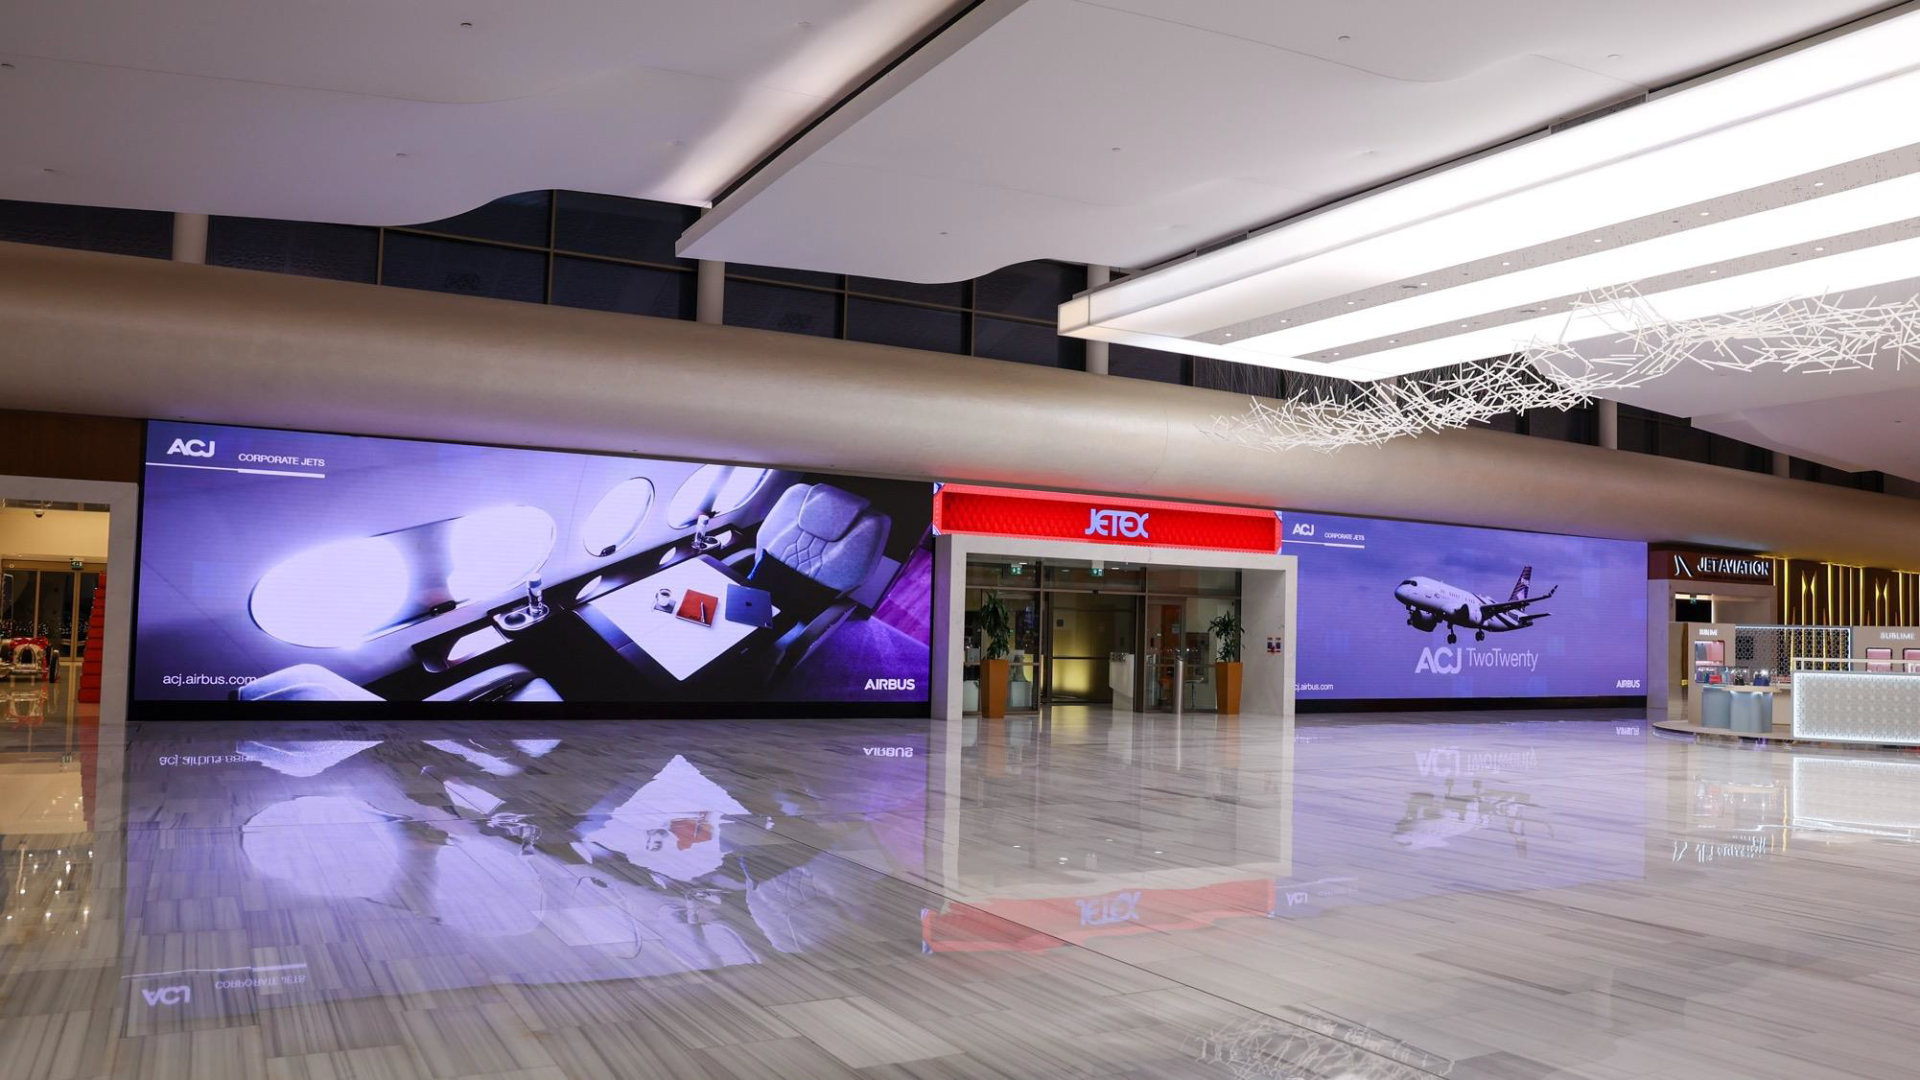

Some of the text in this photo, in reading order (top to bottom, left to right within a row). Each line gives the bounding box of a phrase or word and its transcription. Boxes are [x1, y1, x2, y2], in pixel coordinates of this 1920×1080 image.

[166, 438, 216, 458] ACJ
[238, 453, 325, 467] CORPORATE JETS
[1084, 508, 1149, 539] JETEX
[1292, 523, 1315, 536] ACJ
[1414, 647, 1539, 675] ACJ TwoTwenty
[864, 678, 916, 691] AIRBUS
